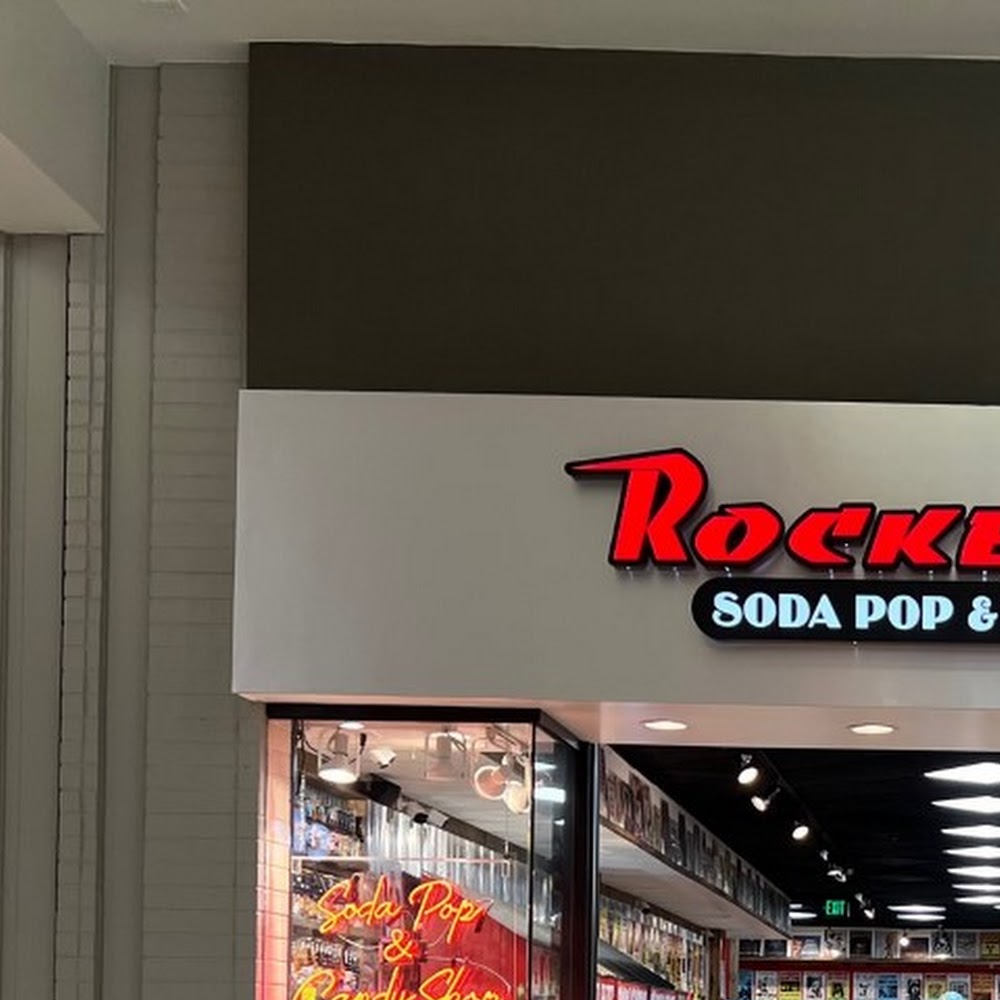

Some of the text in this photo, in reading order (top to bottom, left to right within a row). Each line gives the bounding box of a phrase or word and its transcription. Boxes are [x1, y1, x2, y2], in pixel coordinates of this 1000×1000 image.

[711, 591, 842, 632] SODA
[854, 595, 955, 633] POP
[967, 600, 998, 634] &
[317, 876, 484, 944] Soda Pop
[825, 899, 846, 916] EXIT
[383, 928, 413, 963] &
